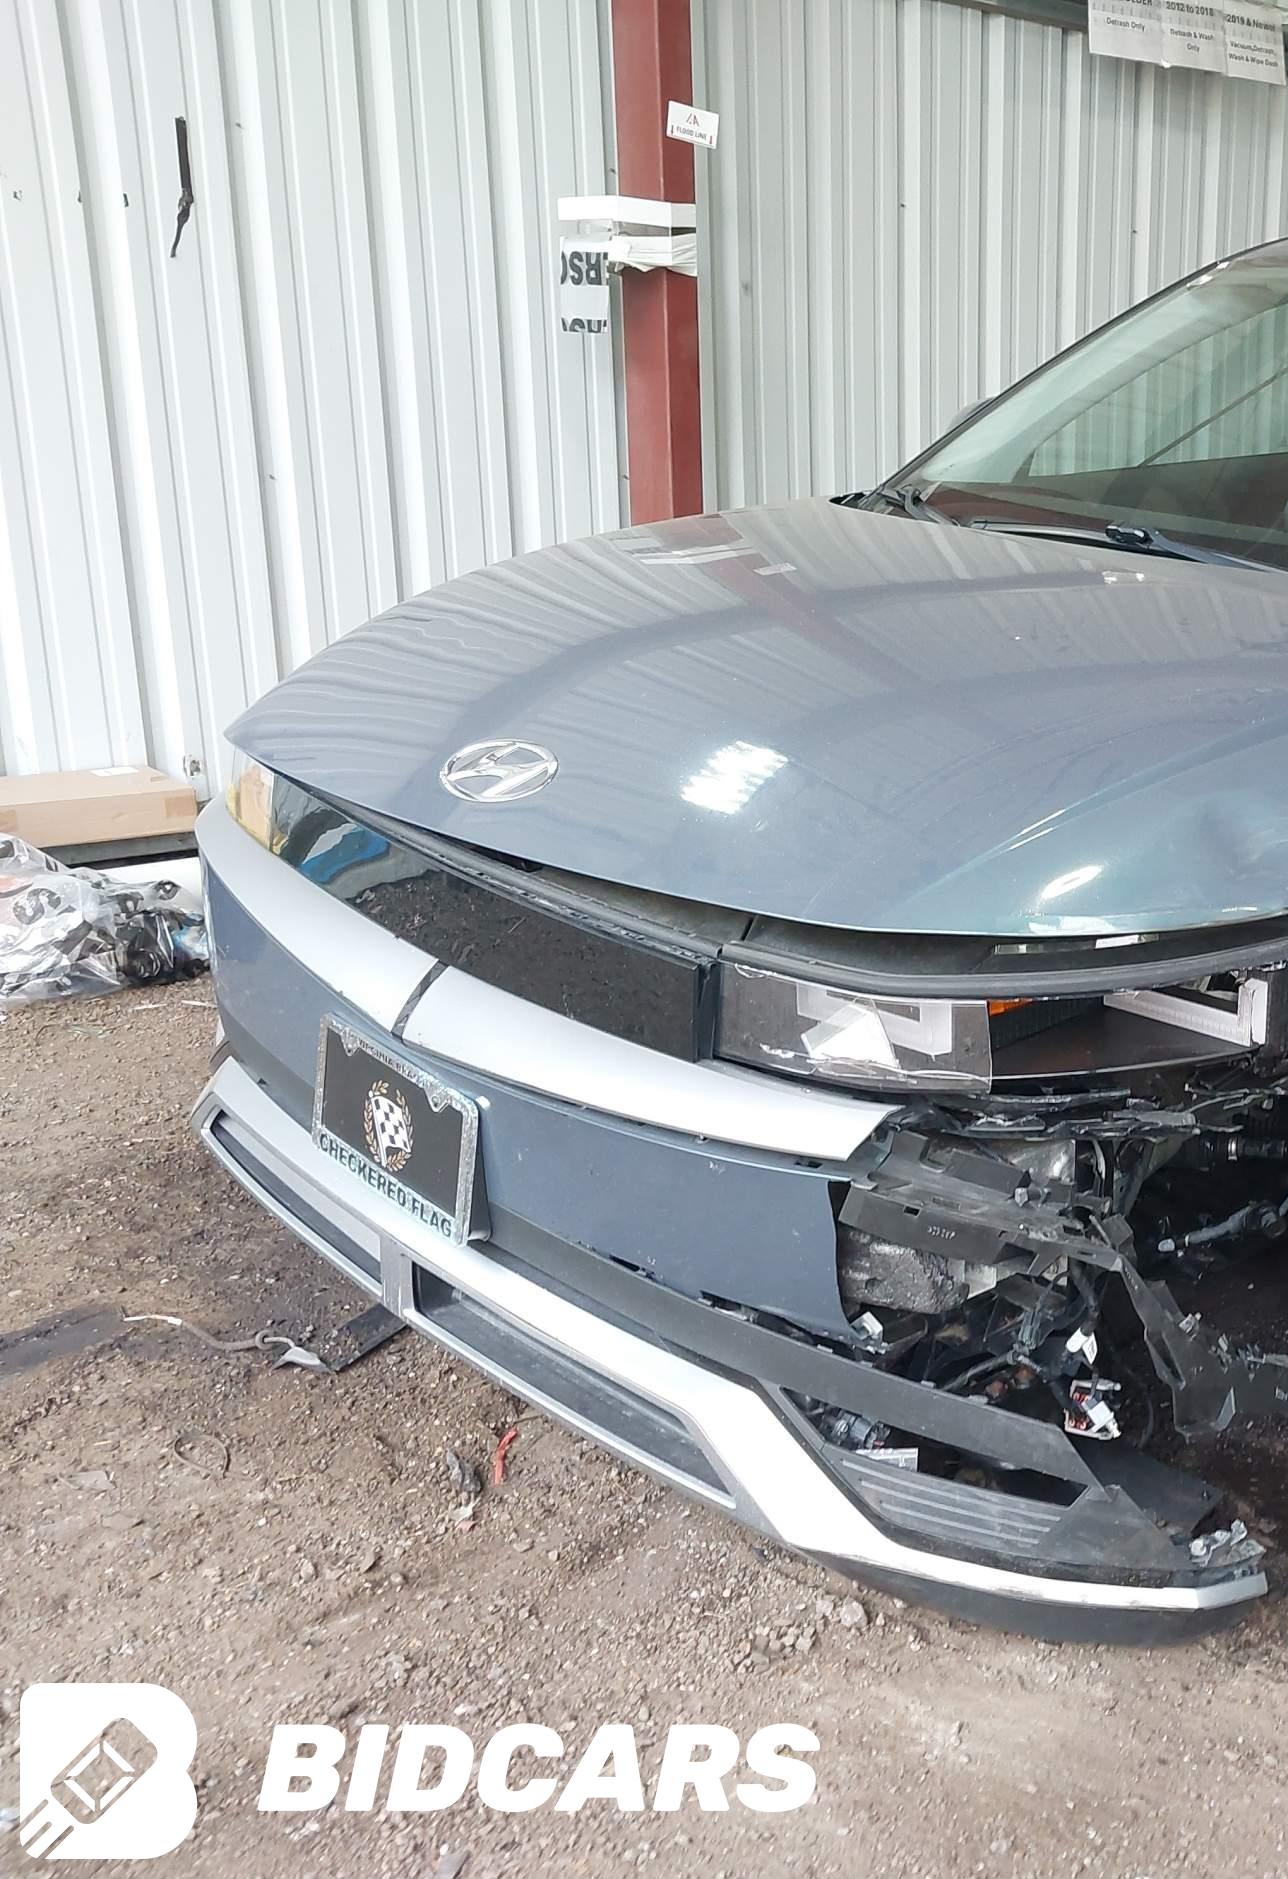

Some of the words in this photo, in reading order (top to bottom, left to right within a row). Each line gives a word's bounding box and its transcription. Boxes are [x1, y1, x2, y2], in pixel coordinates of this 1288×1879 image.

[1166, 1, 1184, 12] 2012
[1186, 4, 1194, 14] to
[319, 1133, 407, 1208] CHECKERED
[411, 1197, 453, 1239] FLAG
